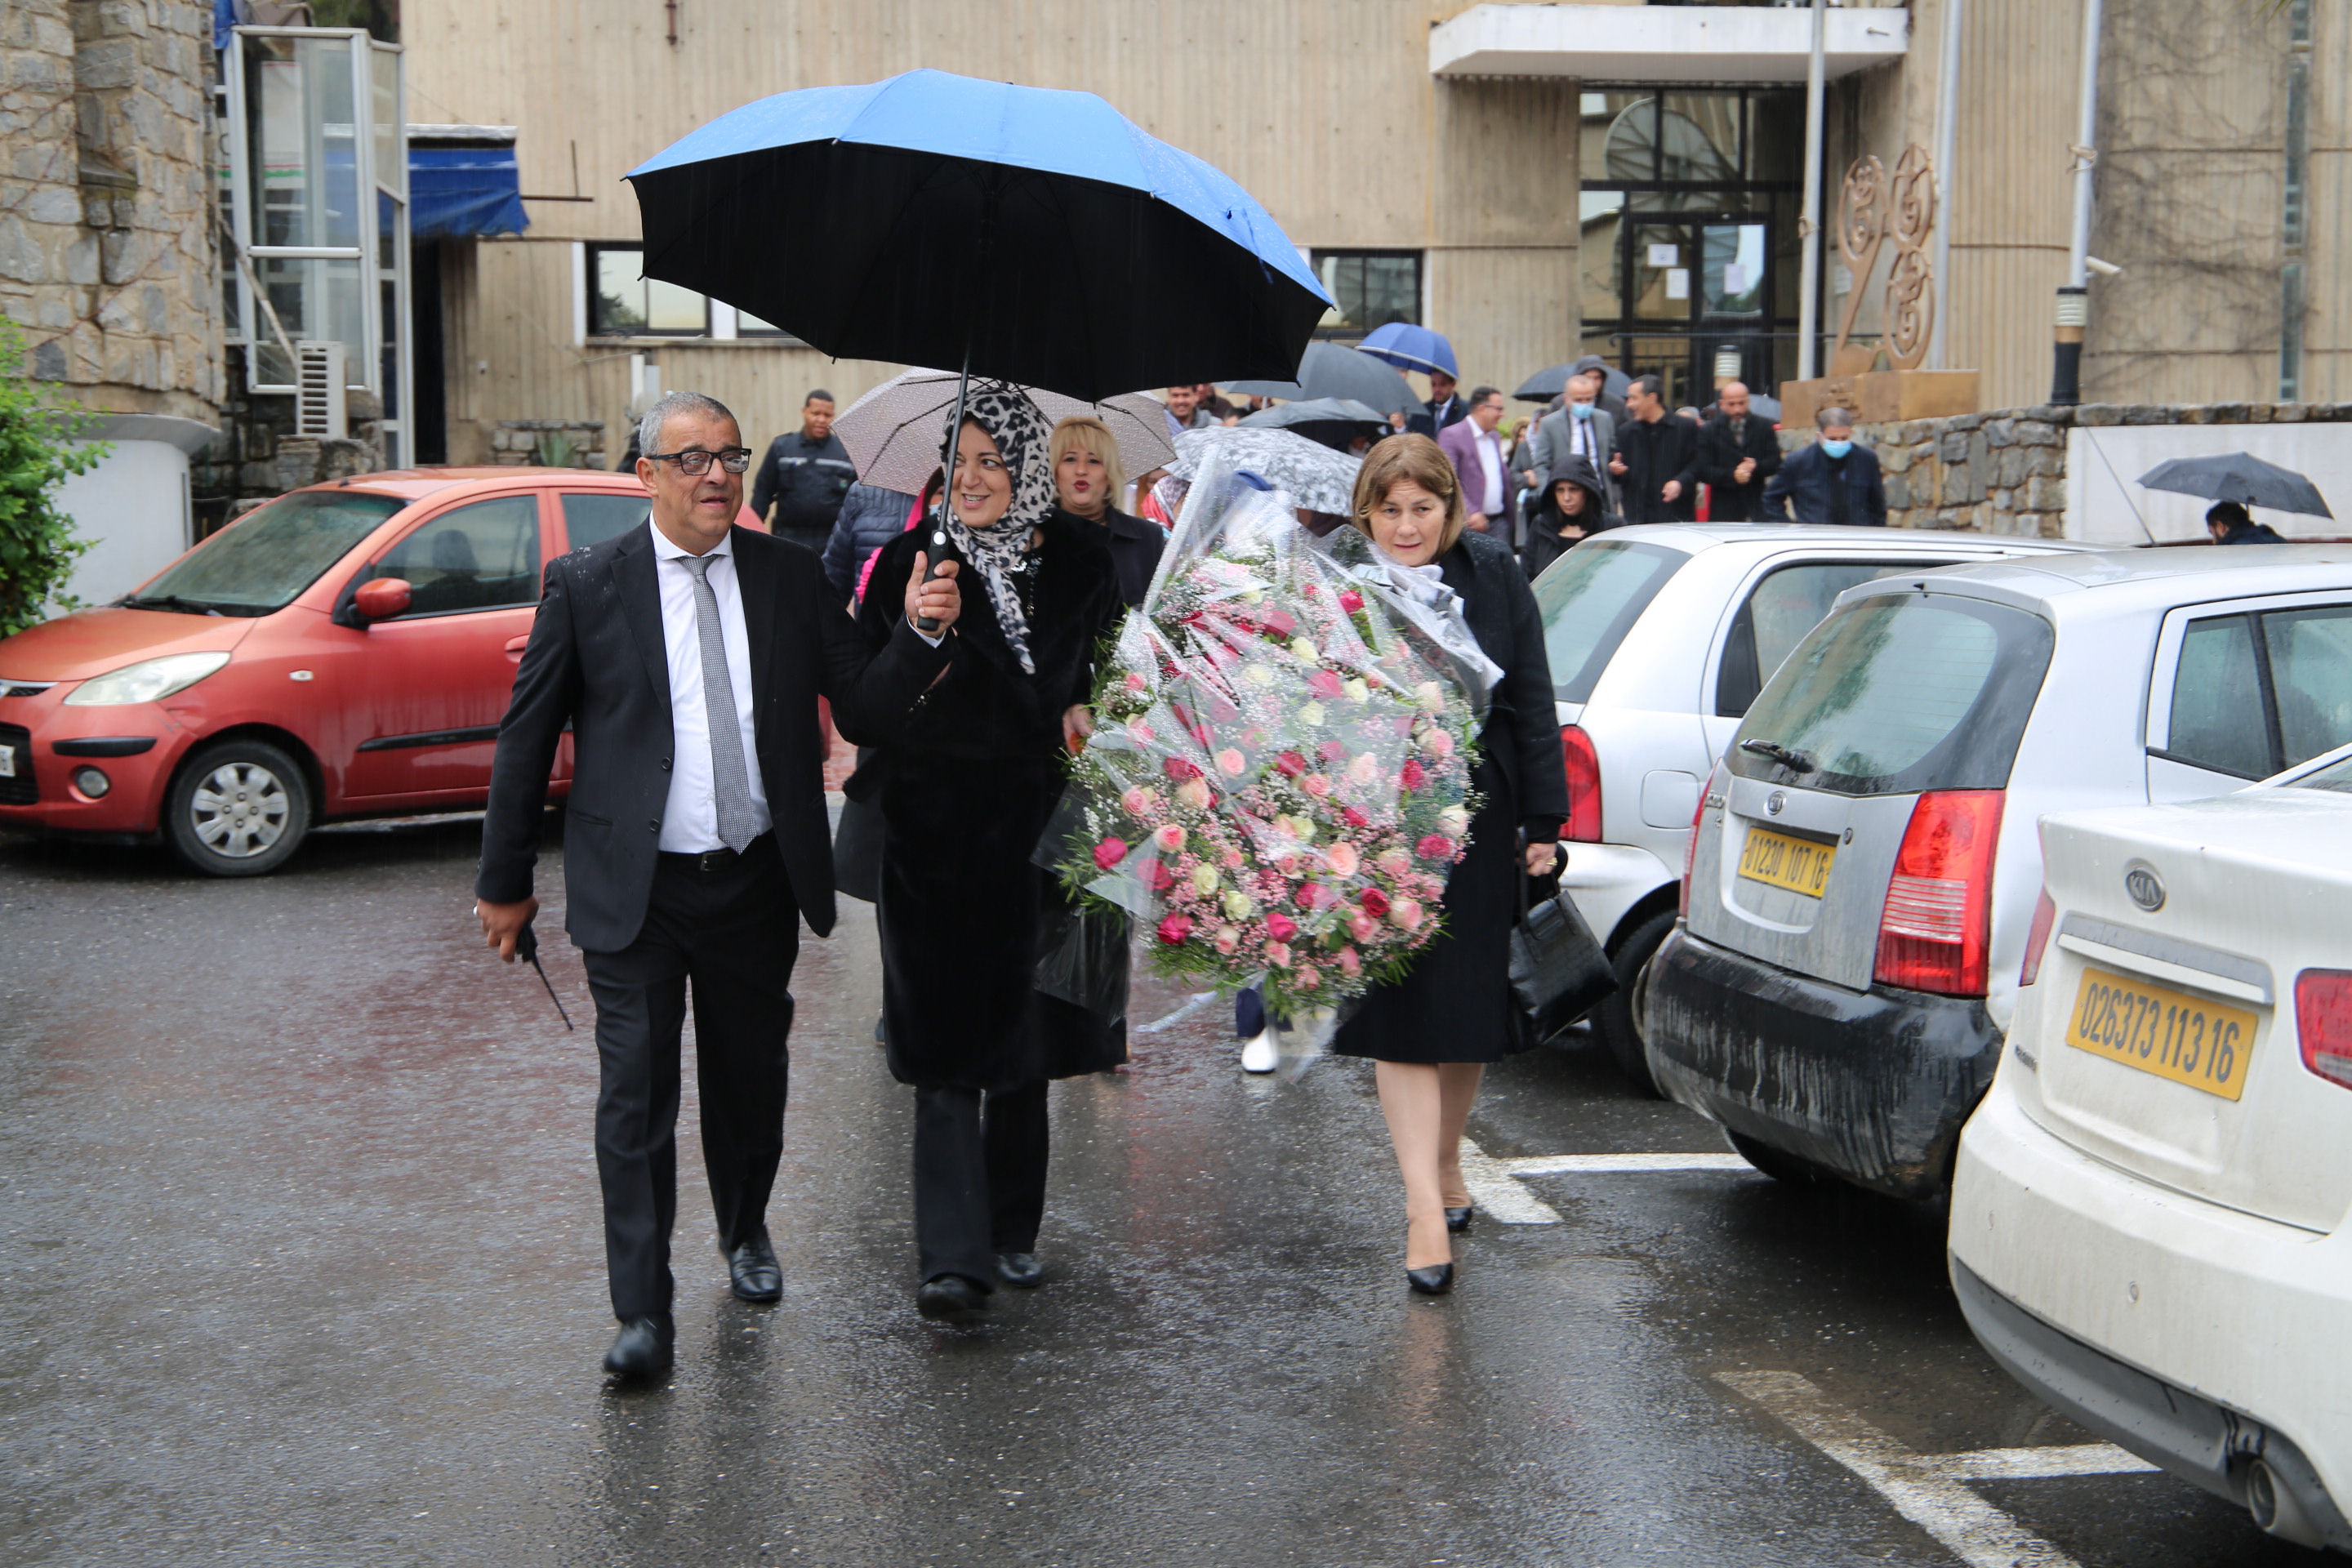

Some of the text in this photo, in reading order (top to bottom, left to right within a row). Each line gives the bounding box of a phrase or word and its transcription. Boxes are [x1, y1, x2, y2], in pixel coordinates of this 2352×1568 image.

[1744, 835, 1829, 889] 01230 107 16
[2127, 874, 2159, 902] KIA
[2079, 982, 2239, 1084] 026373 113 16
